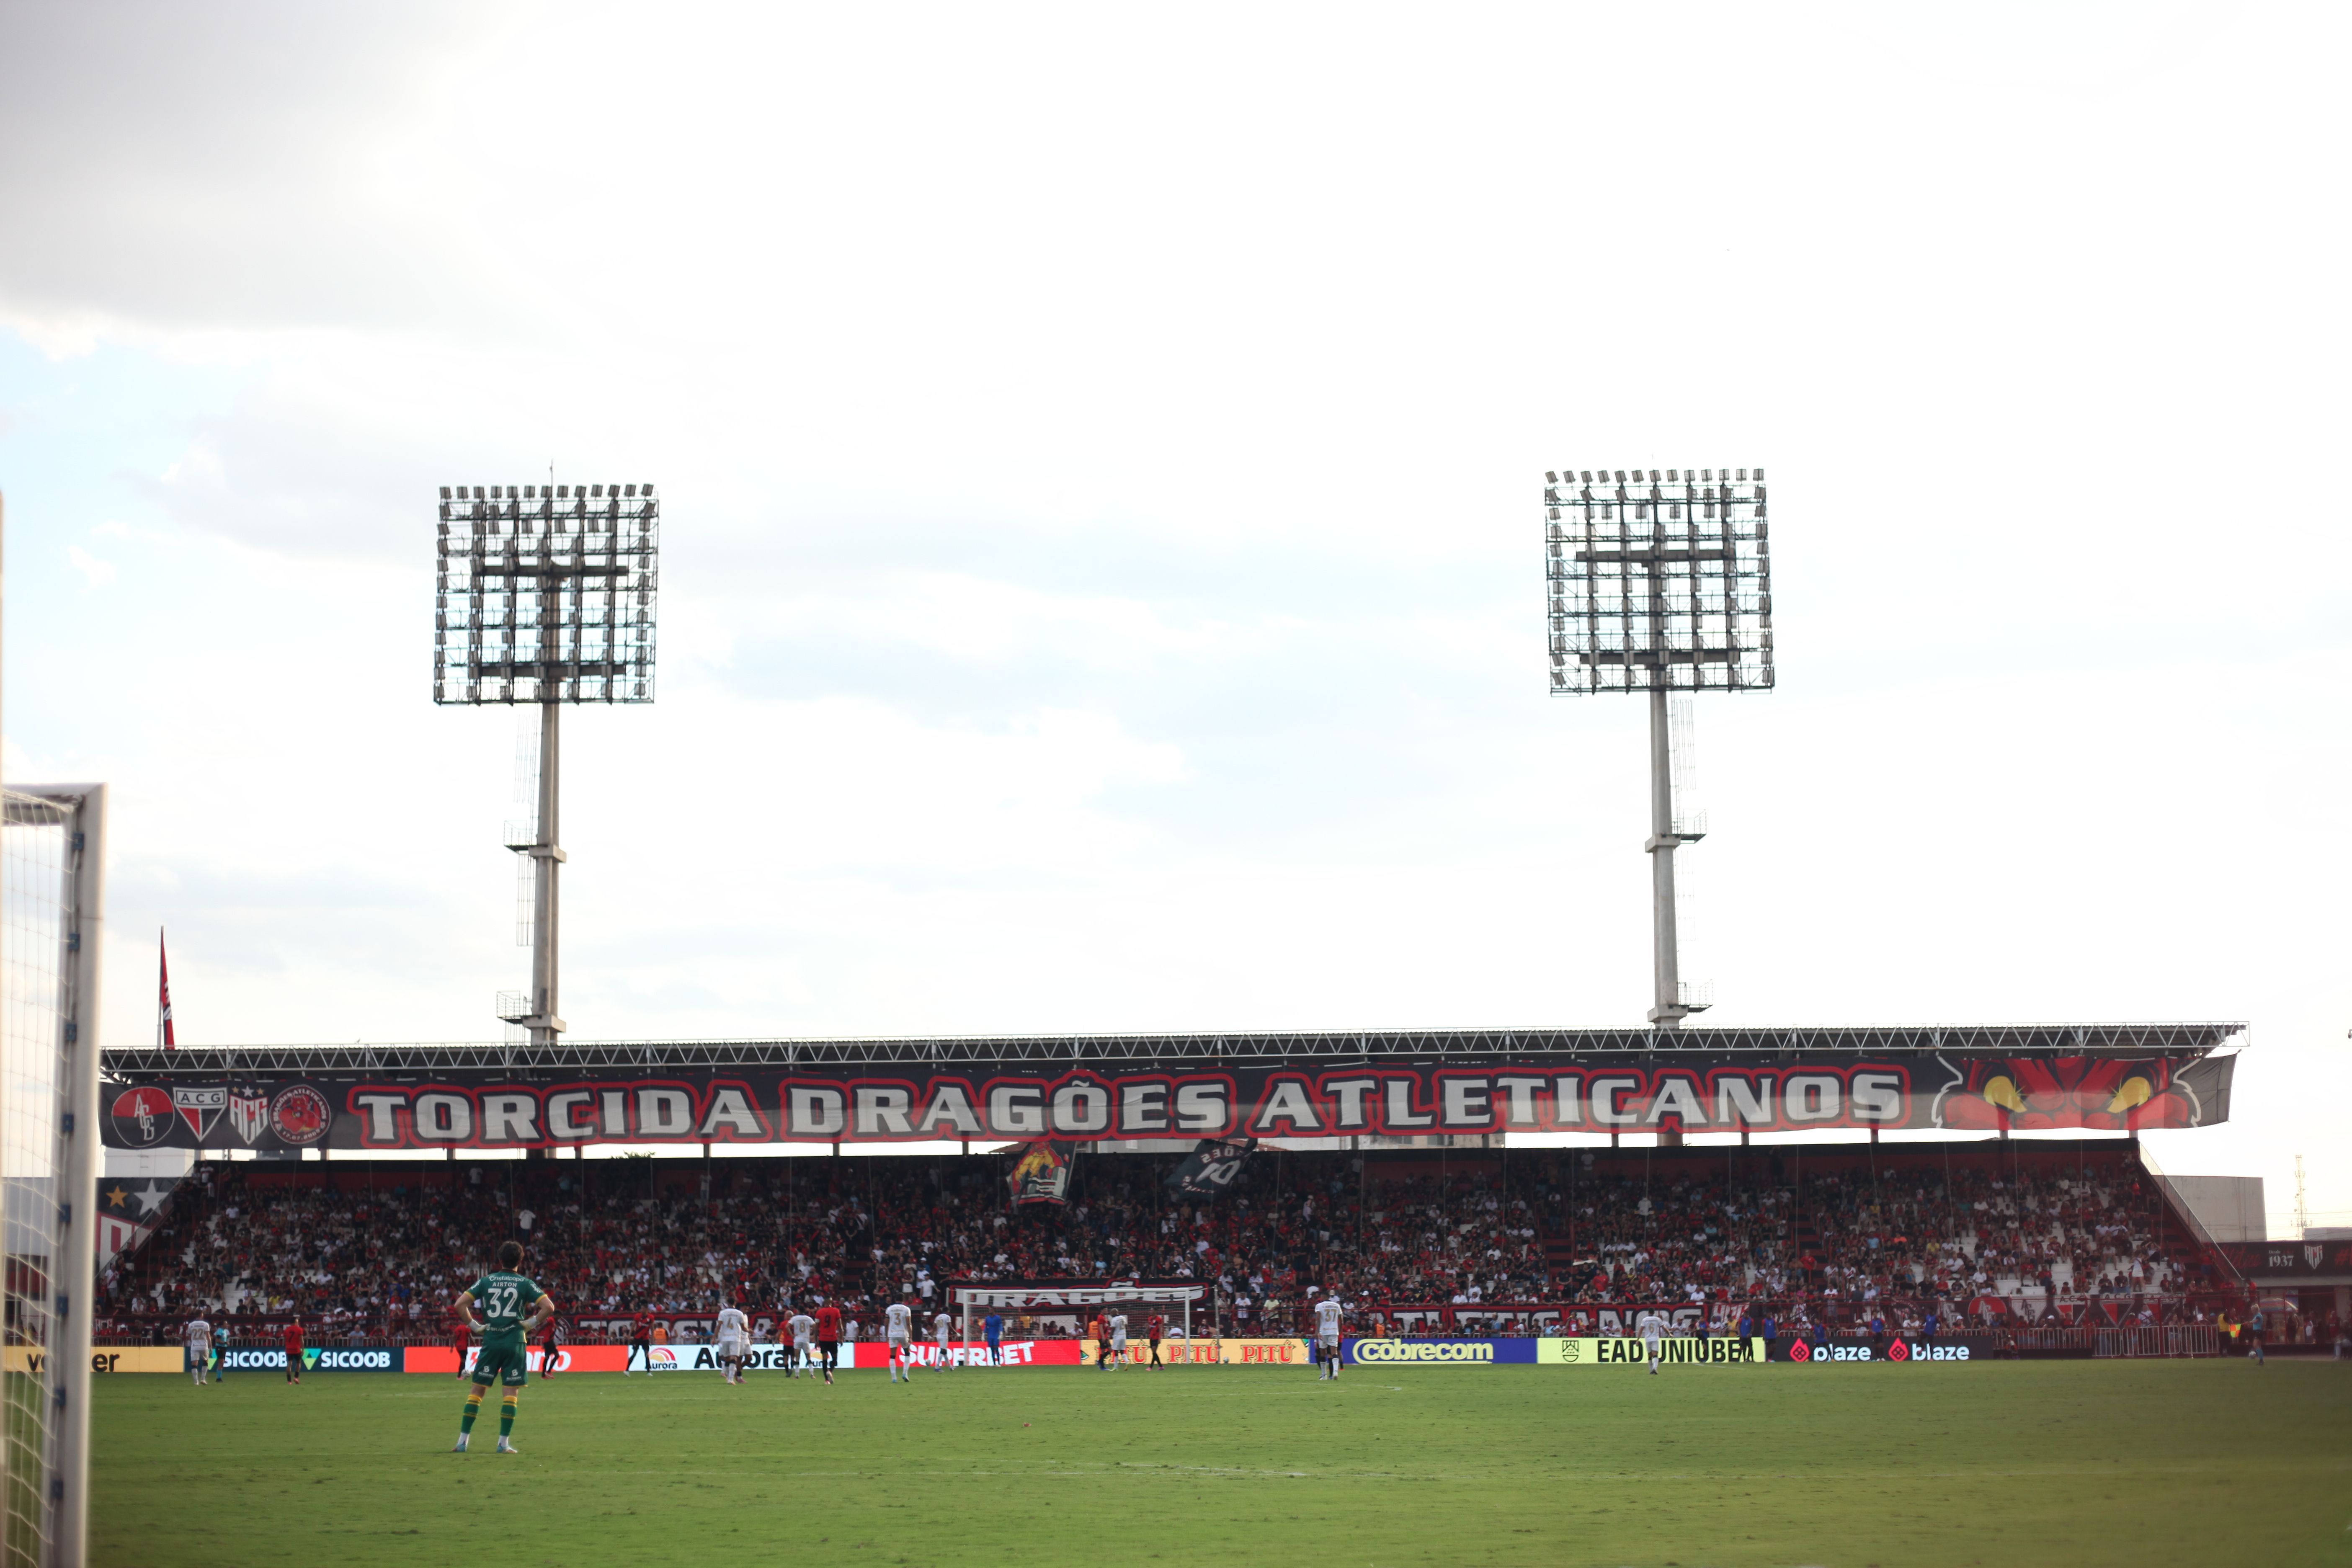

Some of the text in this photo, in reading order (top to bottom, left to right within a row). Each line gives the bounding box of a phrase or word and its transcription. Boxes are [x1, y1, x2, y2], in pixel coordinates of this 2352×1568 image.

[180, 1093, 221, 1103] ACG
[358, 1073, 1901, 1140] TORCIDA DRAGÕES ATLETICANOS
[134, 1094, 154, 1141] ACG
[230, 1094, 268, 1145] ACG
[2268, 1255, 2295, 1267] 1937
[2304, 1245, 2323, 1269] ACG
[487, 1287, 518, 1318] 32
[727, 1317, 734, 1330] 4
[824, 1315, 831, 1328] 9
[894, 1313, 902, 1326] 3
[1324, 1309, 1338, 1322] 37
[191, 1328, 204, 1340] 22
[799, 1322, 806, 1333] 8
[1649, 1323, 1654, 1333] 6
[223, 1351, 288, 1367] SICOOB
[1240, 1339, 1294, 1364] PITÚ
[1597, 1340, 1643, 1362] EAD
[1911, 1343, 1970, 1361] blaze
[321, 1351, 391, 1368] SICOOB
